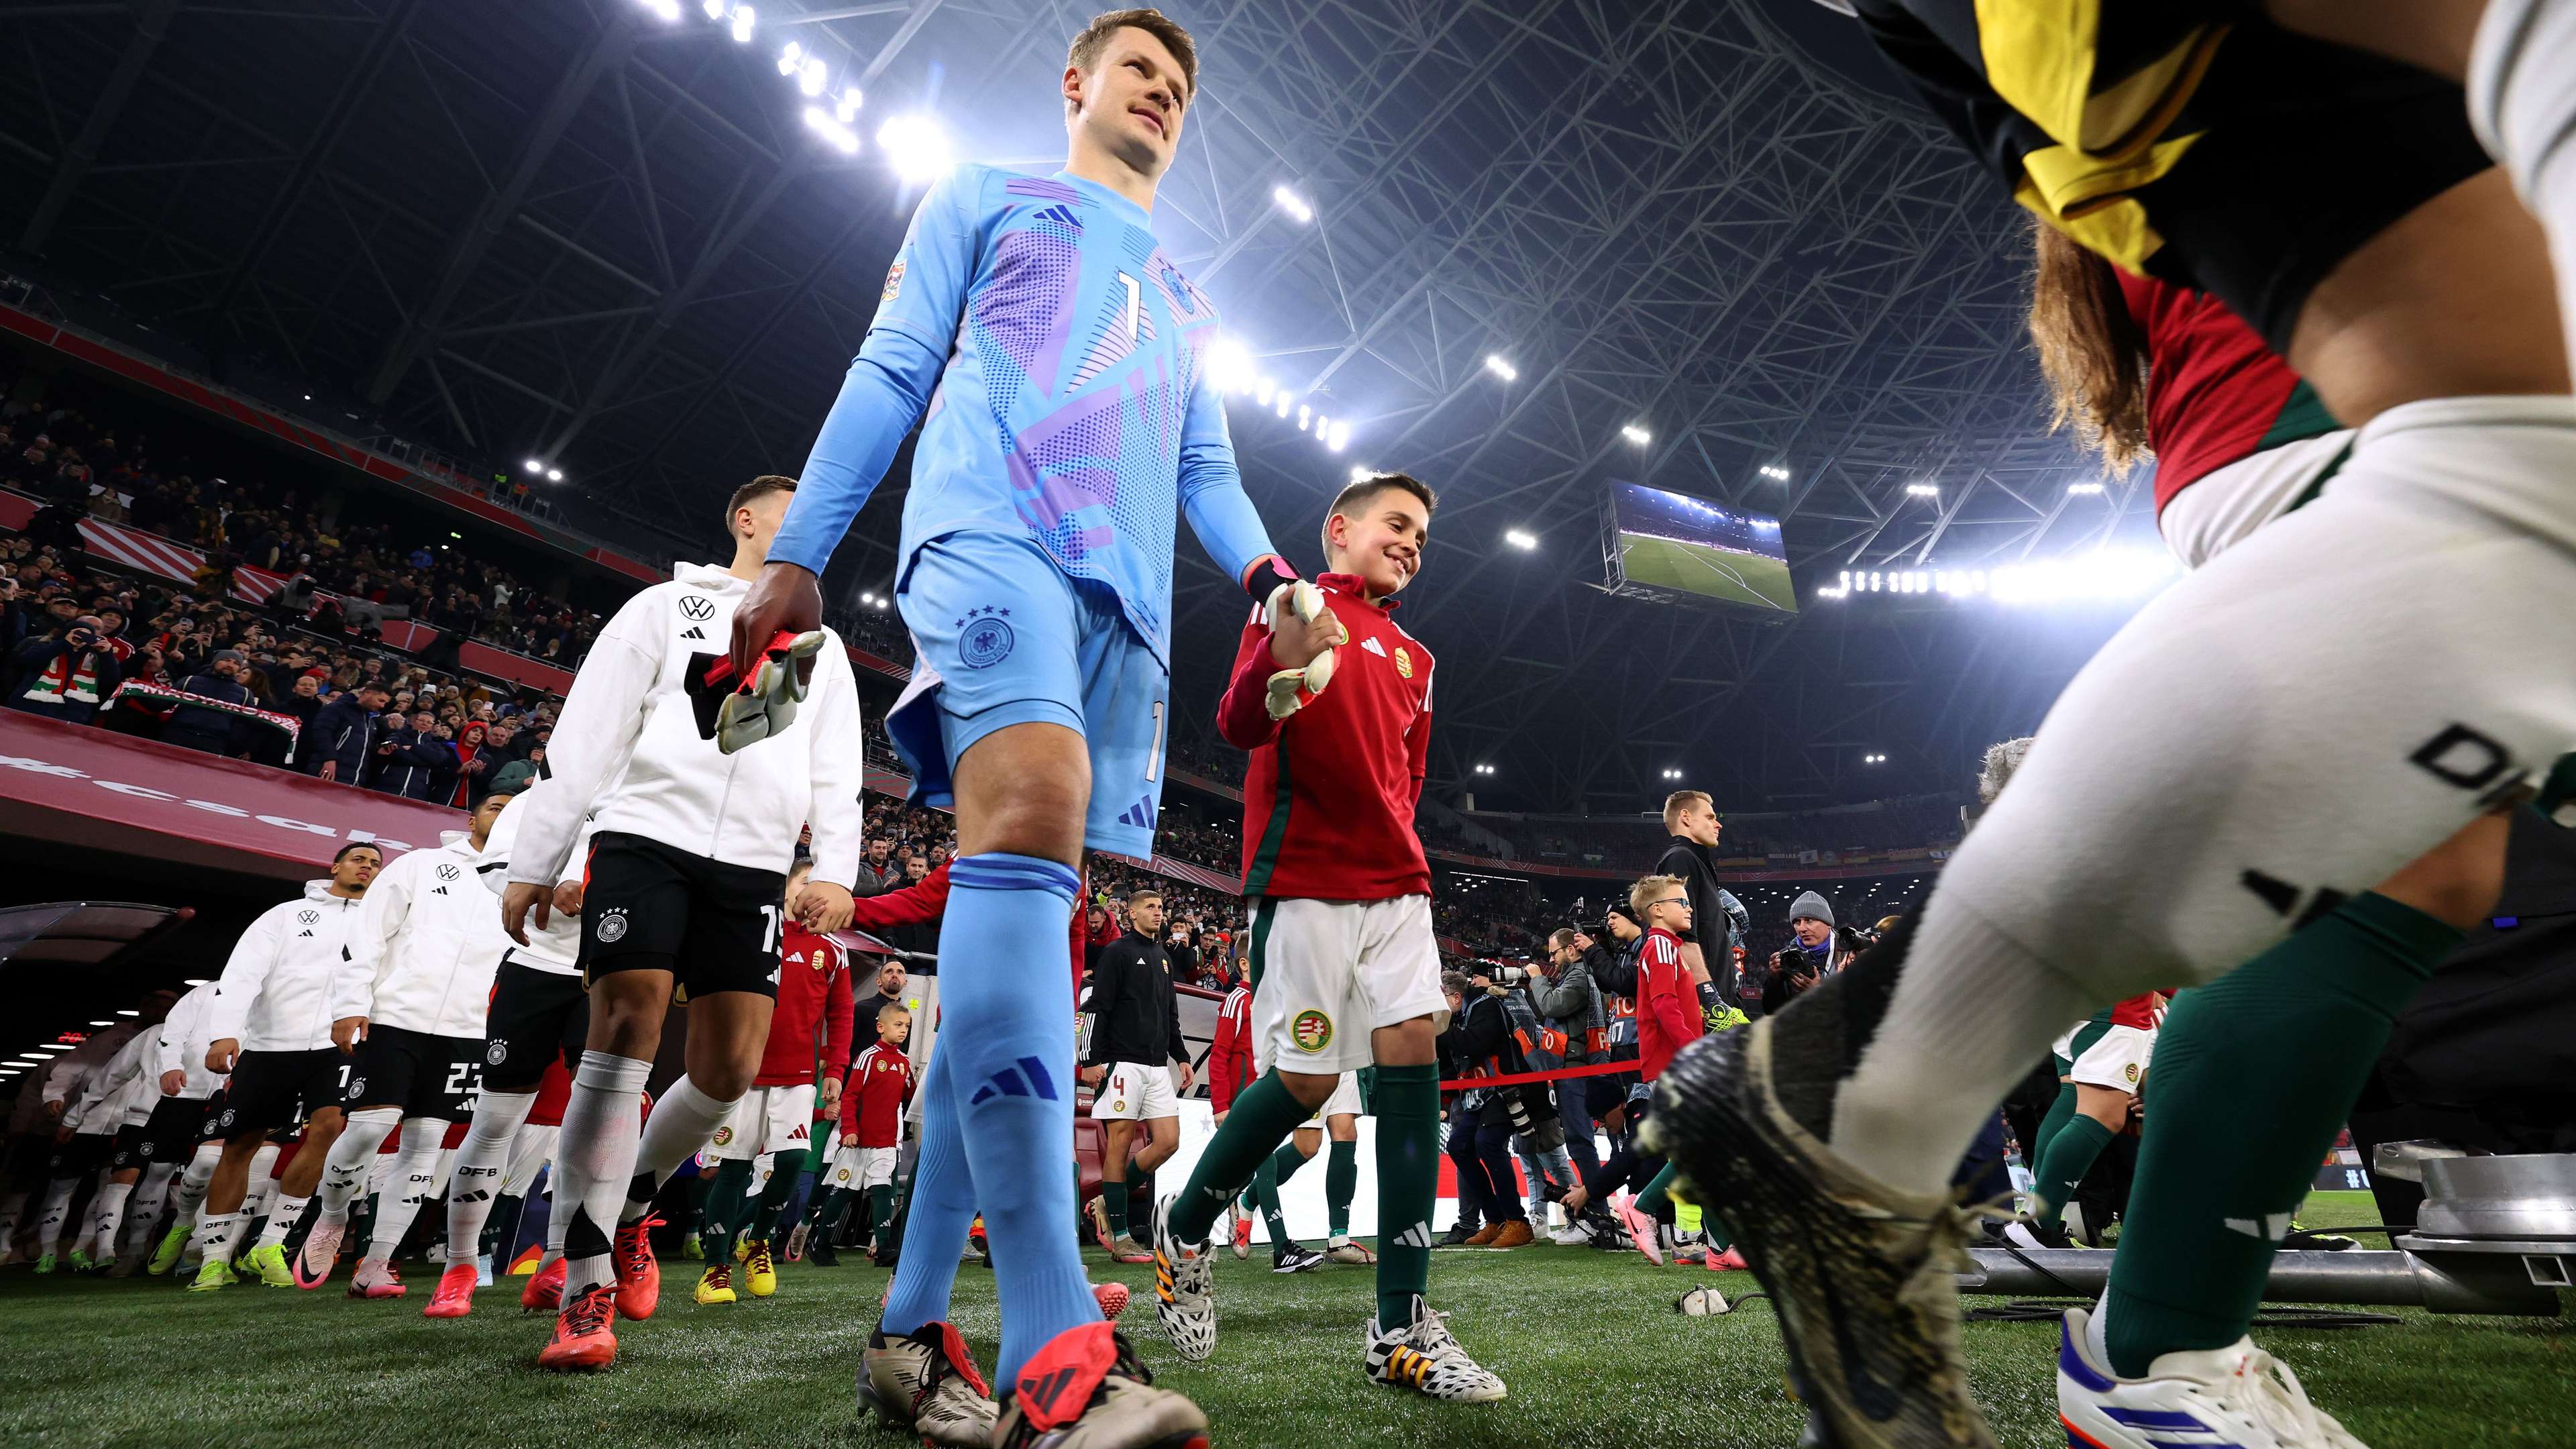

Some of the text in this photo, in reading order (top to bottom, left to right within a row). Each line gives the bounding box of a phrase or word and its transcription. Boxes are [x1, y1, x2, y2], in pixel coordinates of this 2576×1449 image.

[1118, 270, 1140, 341] 1
[1145, 701, 1165, 783] 1
[444, 1063, 483, 1093] 23
[1114, 1074, 1124, 1095] 4
[331, 1165, 365, 1175] DFB
[458, 1166, 498, 1177] DFB
[205, 1220, 230, 1229] DFB
